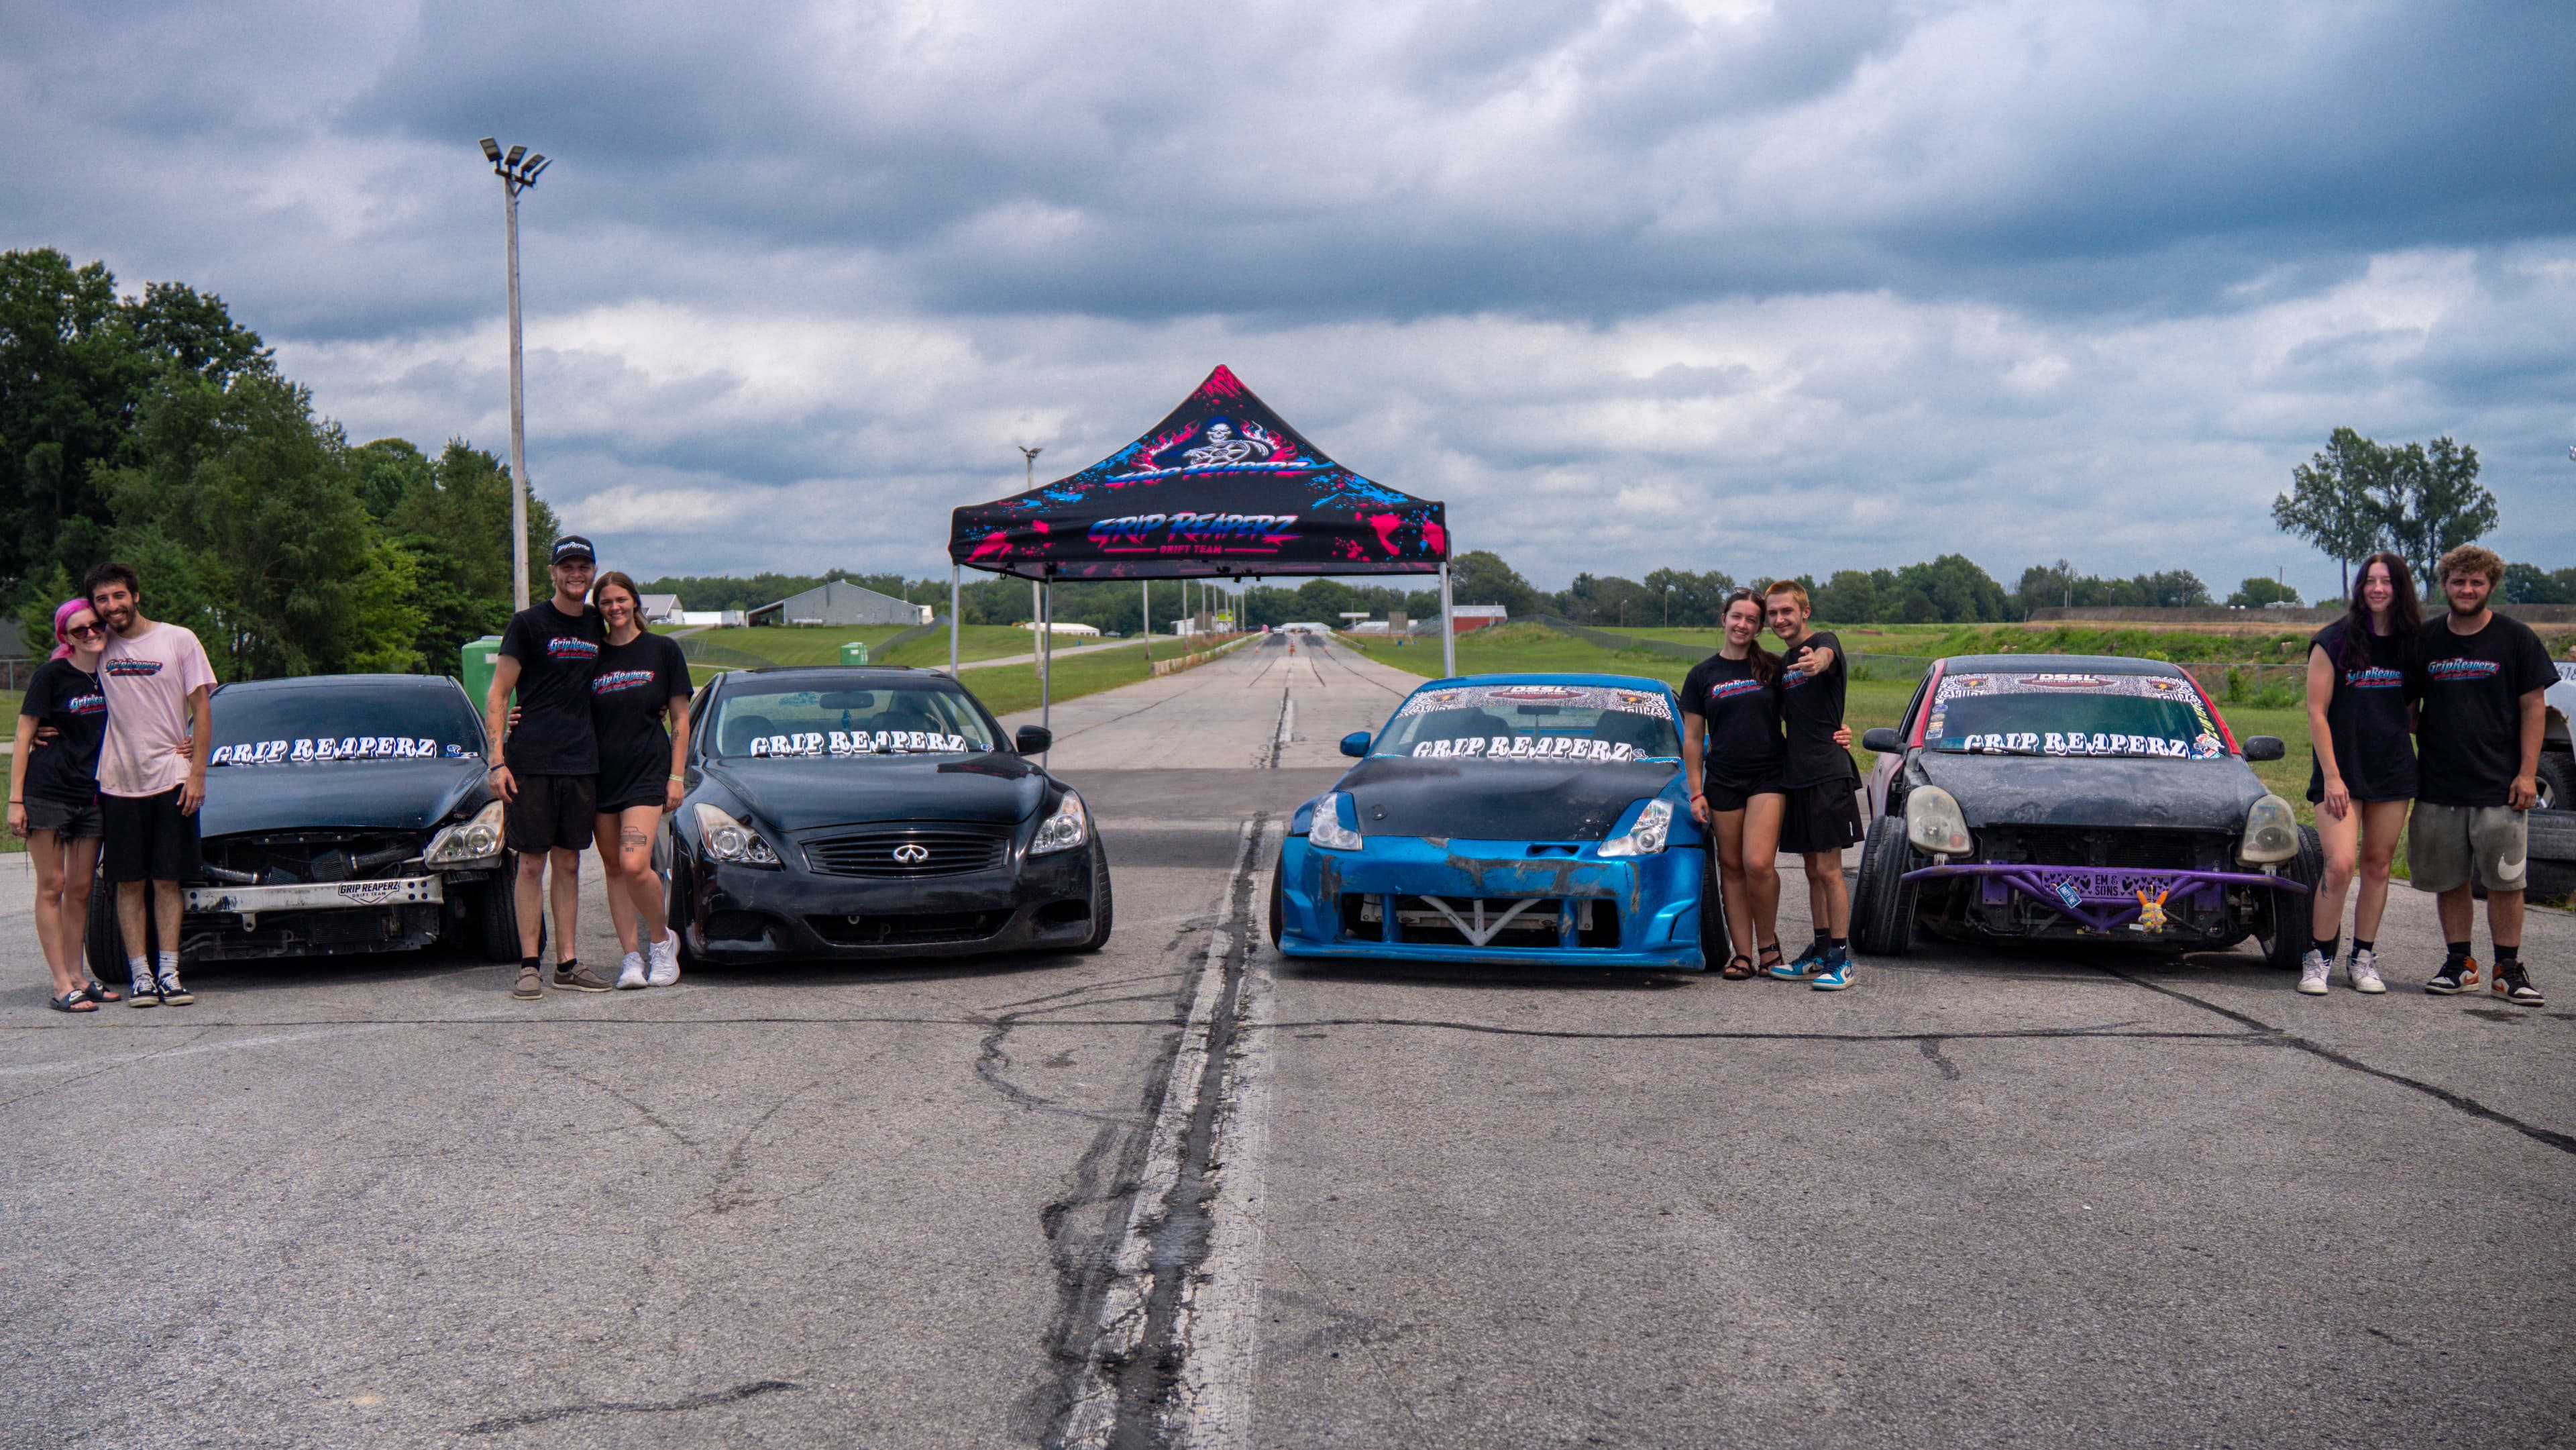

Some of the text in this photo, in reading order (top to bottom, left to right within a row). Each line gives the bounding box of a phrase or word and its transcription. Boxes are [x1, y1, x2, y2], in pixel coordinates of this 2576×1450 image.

[1087, 511, 1303, 548] GRIP REAPERZ
[1160, 545, 1222, 554] DRIFT TEAM
[549, 637, 598, 653] GripReaperz
[2428, 658, 2498, 674] GripReaperz
[592, 671, 651, 691] GripReaperz
[211, 737, 437, 766] GRIP REAPERZ
[751, 731, 968, 758] GRIP REAPERZ
[1413, 736, 1633, 762] GRIP REAPERZ
[1964, 732, 2191, 760] GRIP REAPERZ
[340, 882, 398, 894] GRIP REAPERZ
[2095, 874, 2118, 885] EM &
[2095, 886, 2118, 896] SONS
